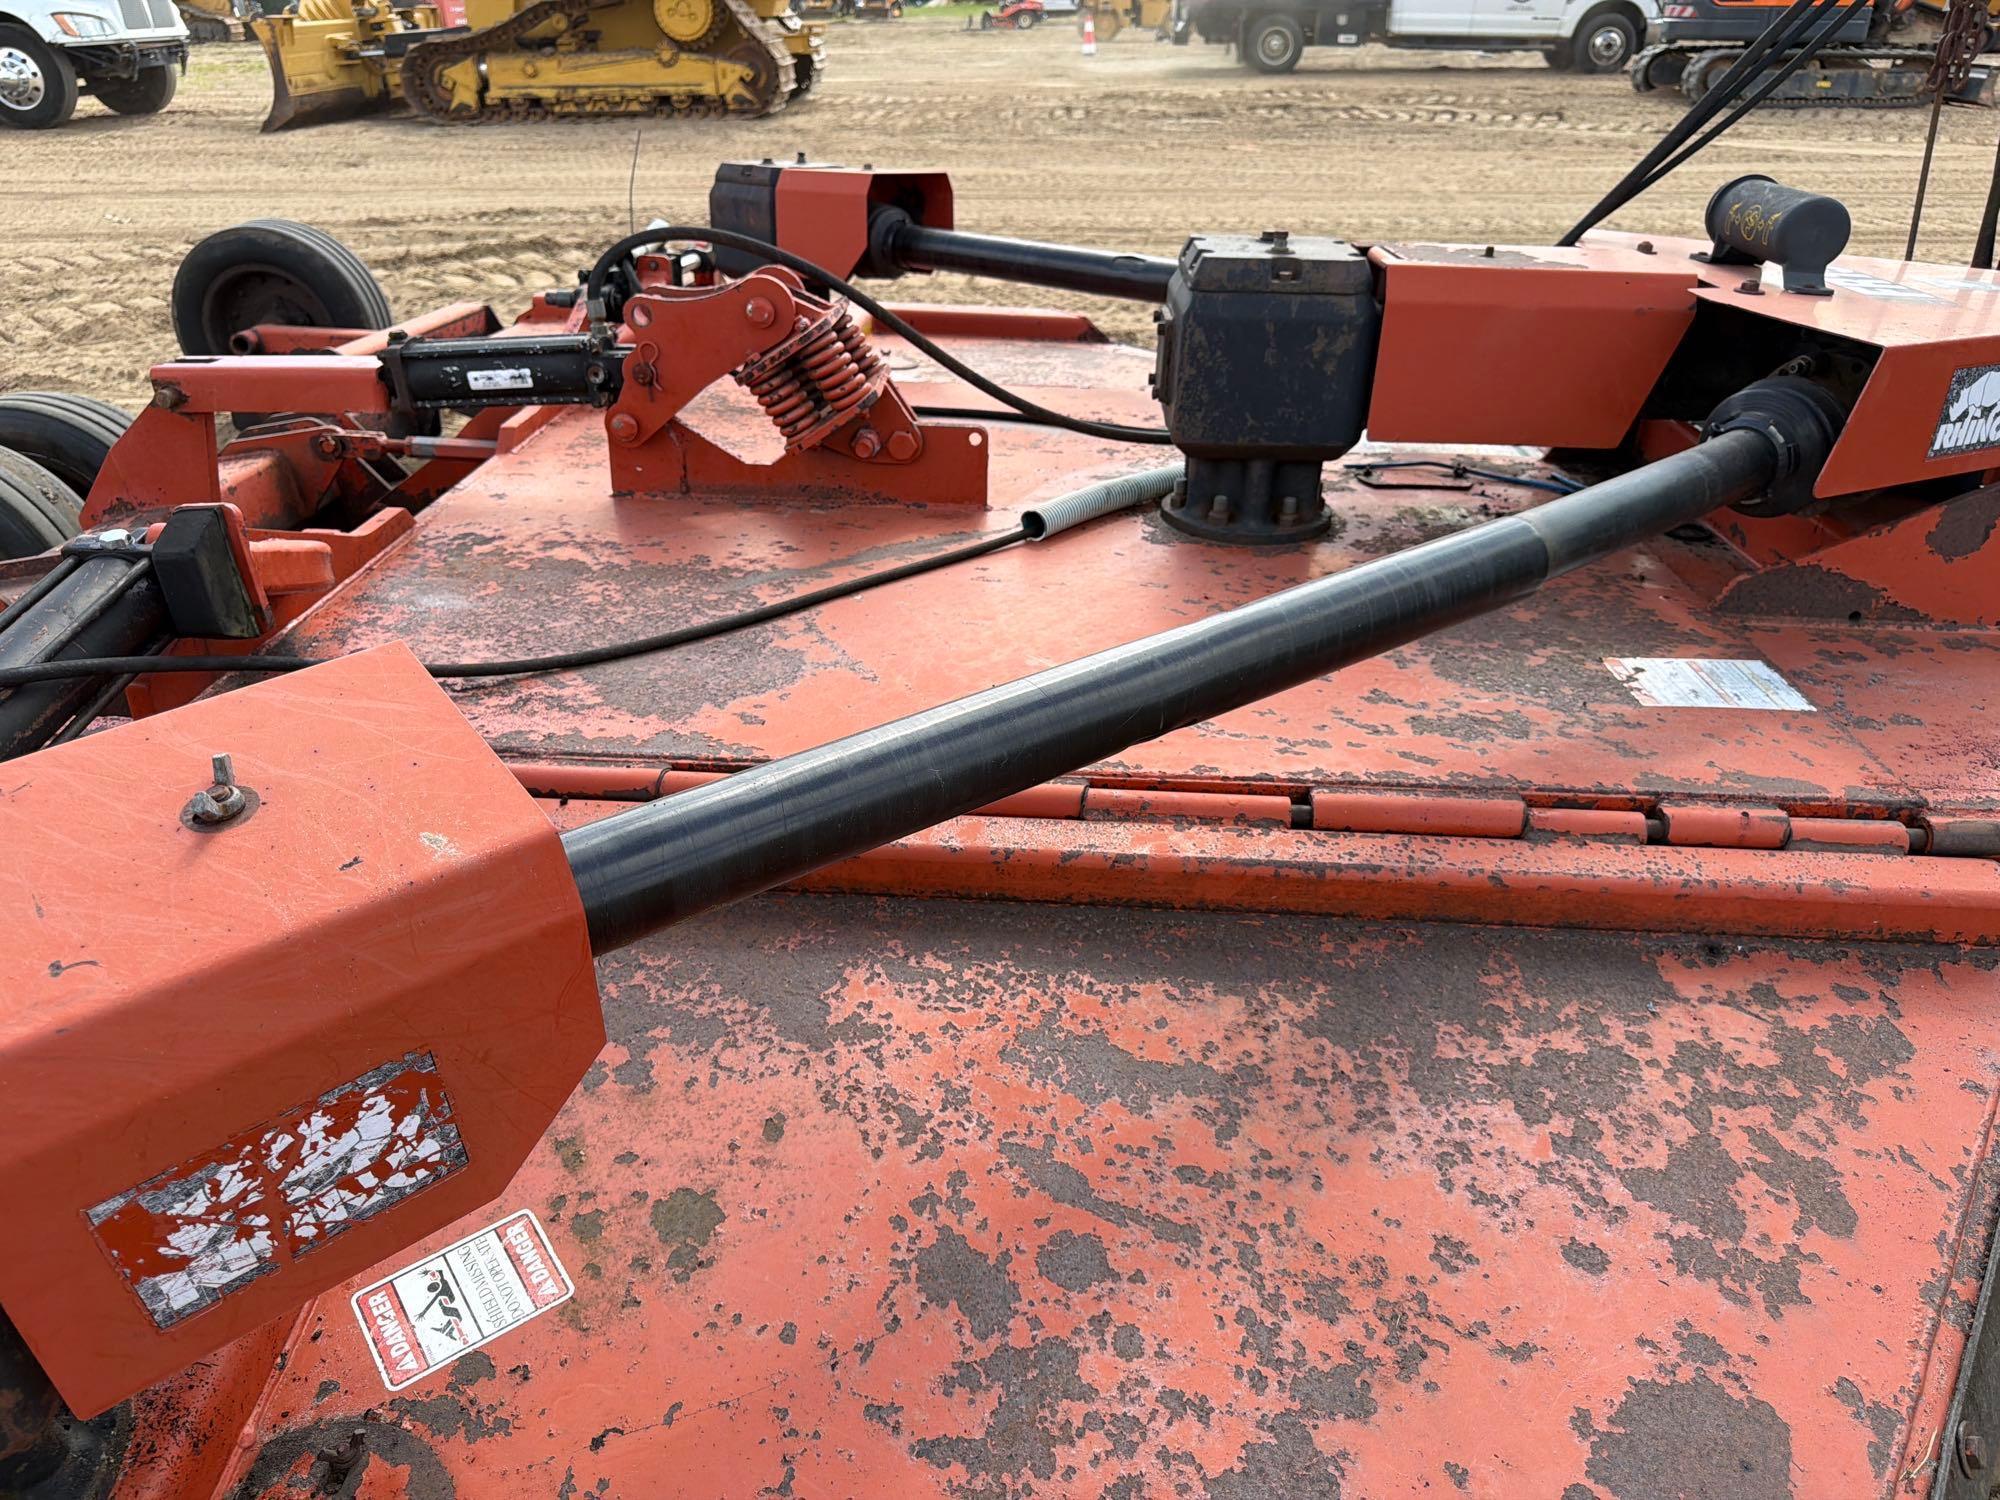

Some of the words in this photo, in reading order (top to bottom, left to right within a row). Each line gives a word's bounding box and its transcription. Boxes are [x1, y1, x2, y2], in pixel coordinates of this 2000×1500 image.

[458, 1244, 489, 1290] MISSING
[474, 1236, 506, 1281] OPERATE
[506, 1219, 551, 1284] DANGER
[479, 1286, 508, 1329] SHIELD
[496, 1281, 515, 1304] NOT
[507, 1300, 525, 1319] DO
[368, 1290, 411, 1359] DANGER
